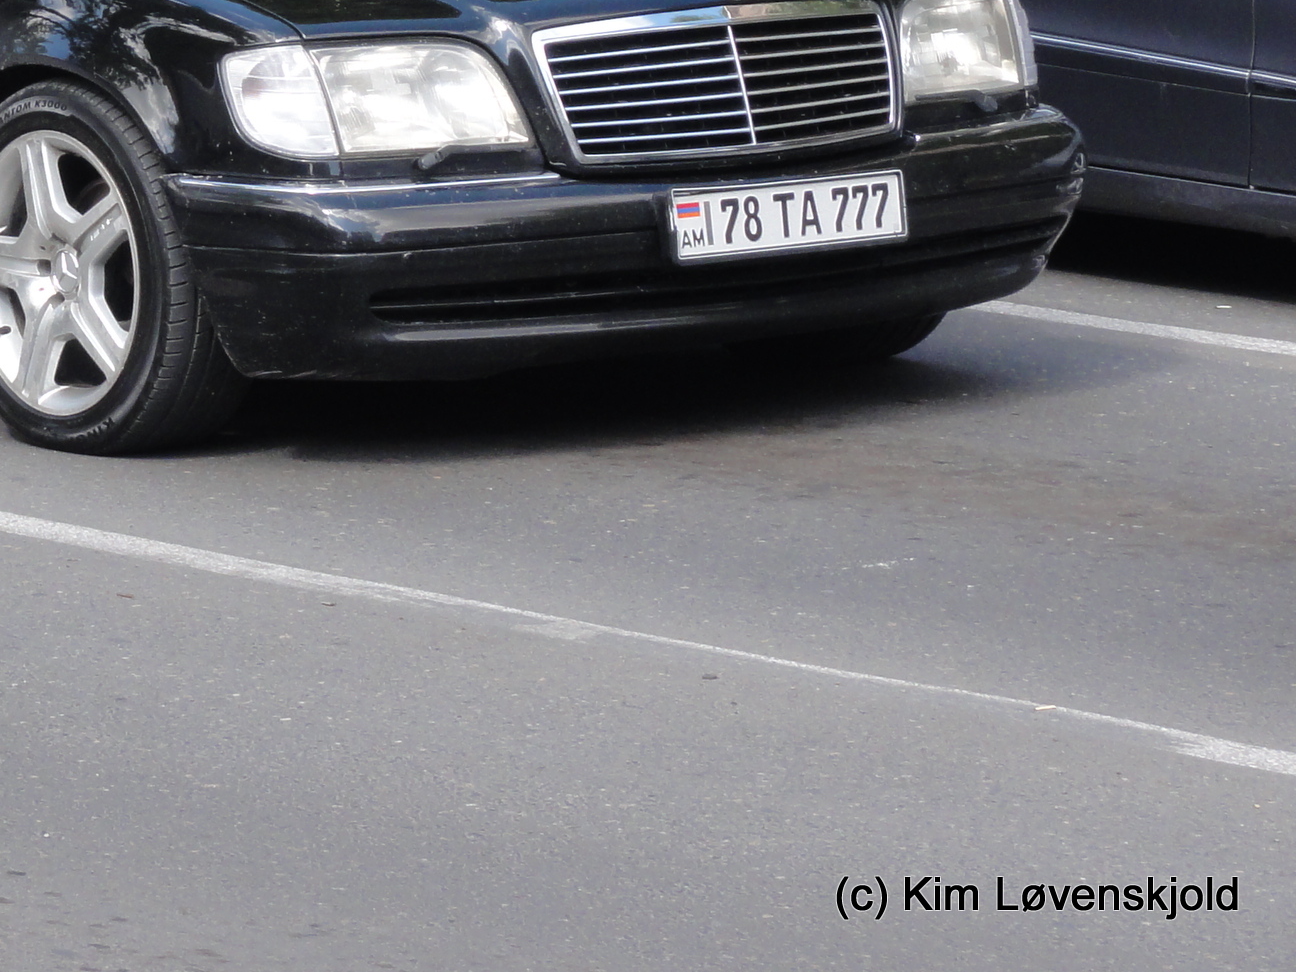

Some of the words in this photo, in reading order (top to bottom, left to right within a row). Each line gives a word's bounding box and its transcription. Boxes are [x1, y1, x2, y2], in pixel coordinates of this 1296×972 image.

[720, 195, 763, 245] 78
[772, 190, 823, 239] TA
[830, 182, 889, 233] 777
[681, 227, 706, 249] AM
